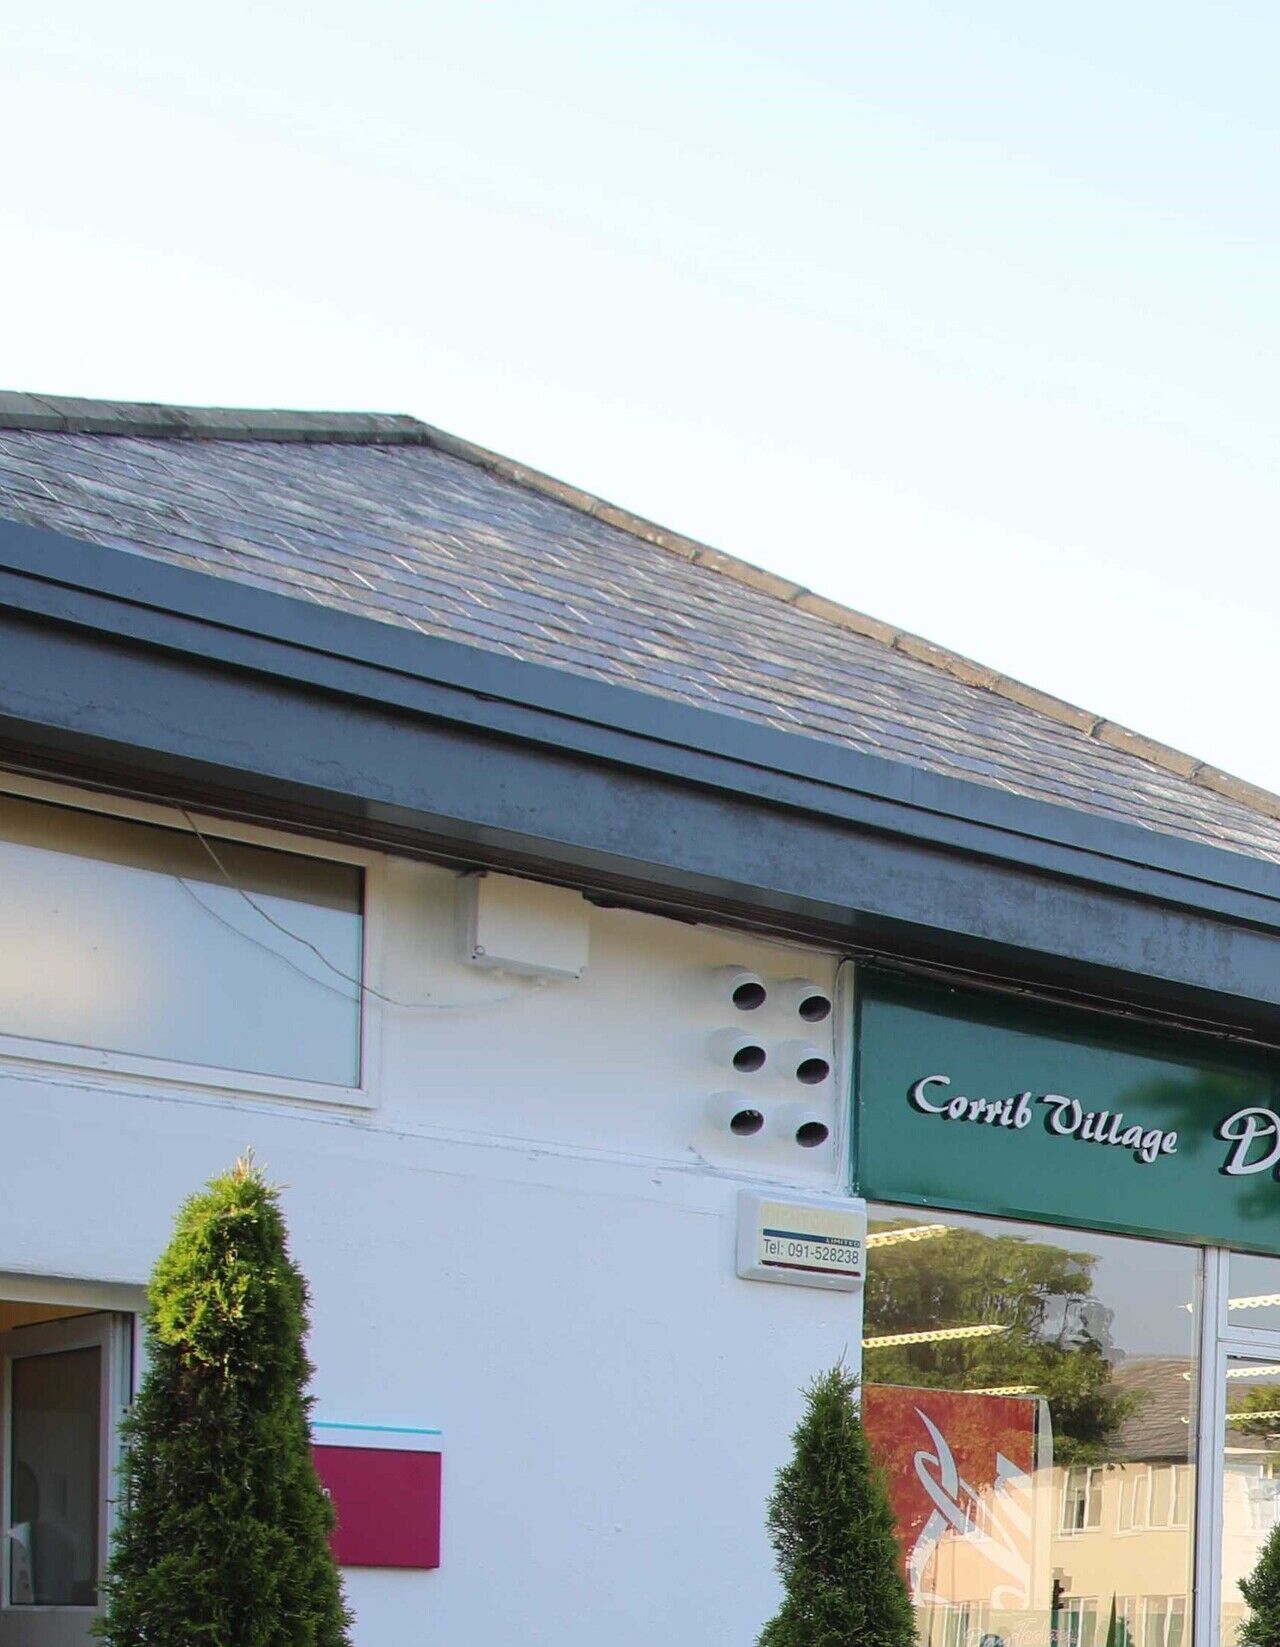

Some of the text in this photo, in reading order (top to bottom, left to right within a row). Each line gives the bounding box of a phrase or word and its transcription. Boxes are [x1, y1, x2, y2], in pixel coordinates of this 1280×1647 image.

[911, 1074, 1178, 1163] Corrib Village
[763, 1239, 859, 1264] Tel: 091-528238
